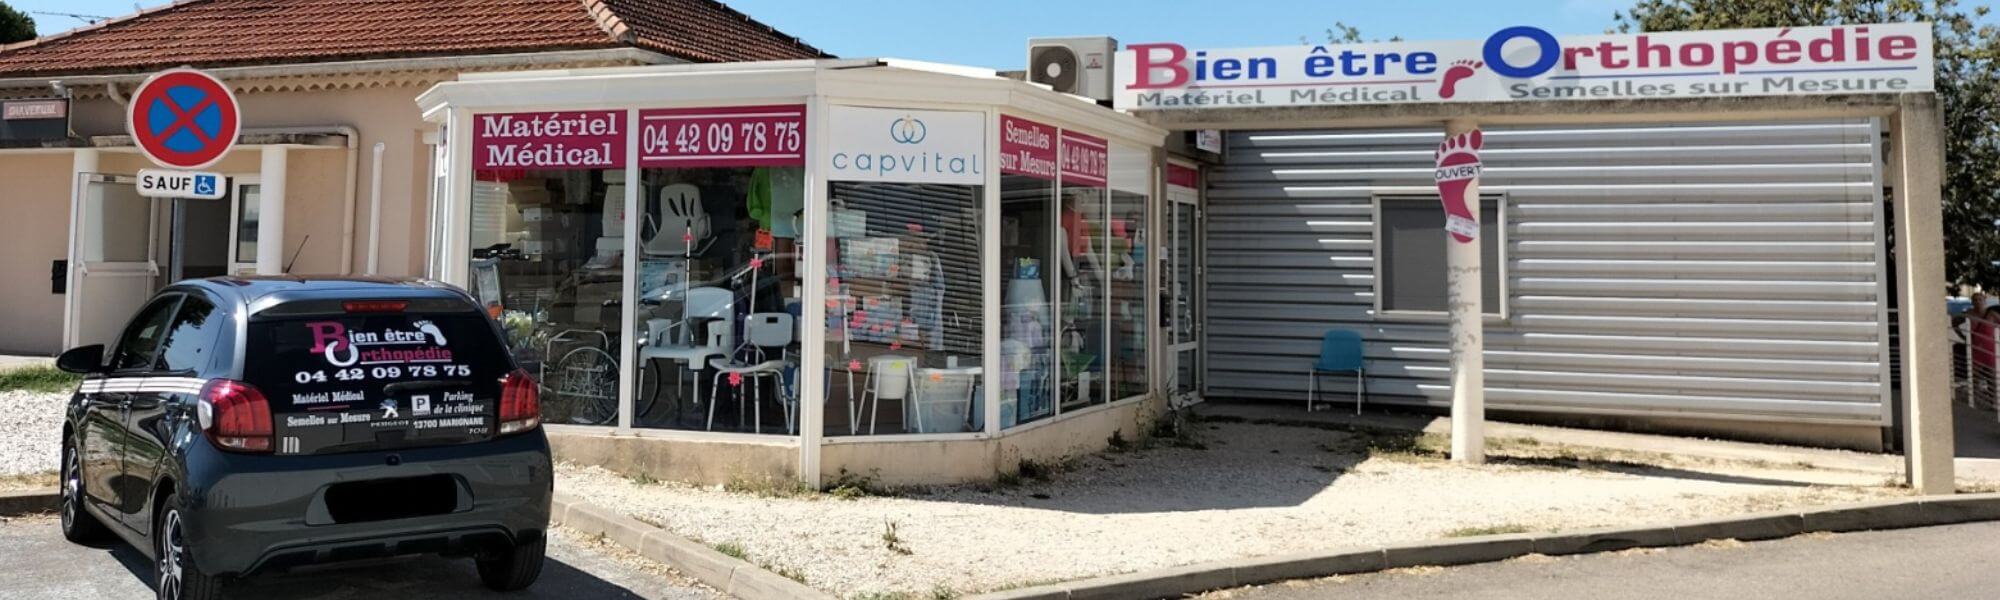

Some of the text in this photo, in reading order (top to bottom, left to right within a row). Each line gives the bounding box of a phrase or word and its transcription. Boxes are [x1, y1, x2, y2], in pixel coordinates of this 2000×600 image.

[1482, 25, 1918, 79] Orthopédie
[1126, 42, 1438, 89] Bien être
[1137, 85, 1420, 107] Matériel Médical
[1510, 76, 1909, 99] Semelles sur Mesure
[482, 113, 618, 138] Matériel
[1005, 119, 1050, 149] Semelles
[643, 121, 801, 154] 04 42 09 78 75
[486, 143, 613, 167] Médical
[832, 151, 980, 177] capvital
[1000, 151, 1056, 177] sur Mesure
[143, 176, 192, 190] SAUF
[1435, 165, 1482, 179] OUVERT
[306, 321, 426, 354] Bien être
[325, 341, 453, 367] Orthopédie
[295, 364, 471, 384] 04 42 09 78 75
[292, 390, 365, 405] Matériel Médical
[433, 404, 444, 414] de
[454, 402, 485, 414] clinique
[443, 391, 474, 402] Parking
[287, 414, 325, 428] Semelles
[340, 412, 372, 424] Mesure
[413, 417, 484, 429] 13700 MARIGNANE
